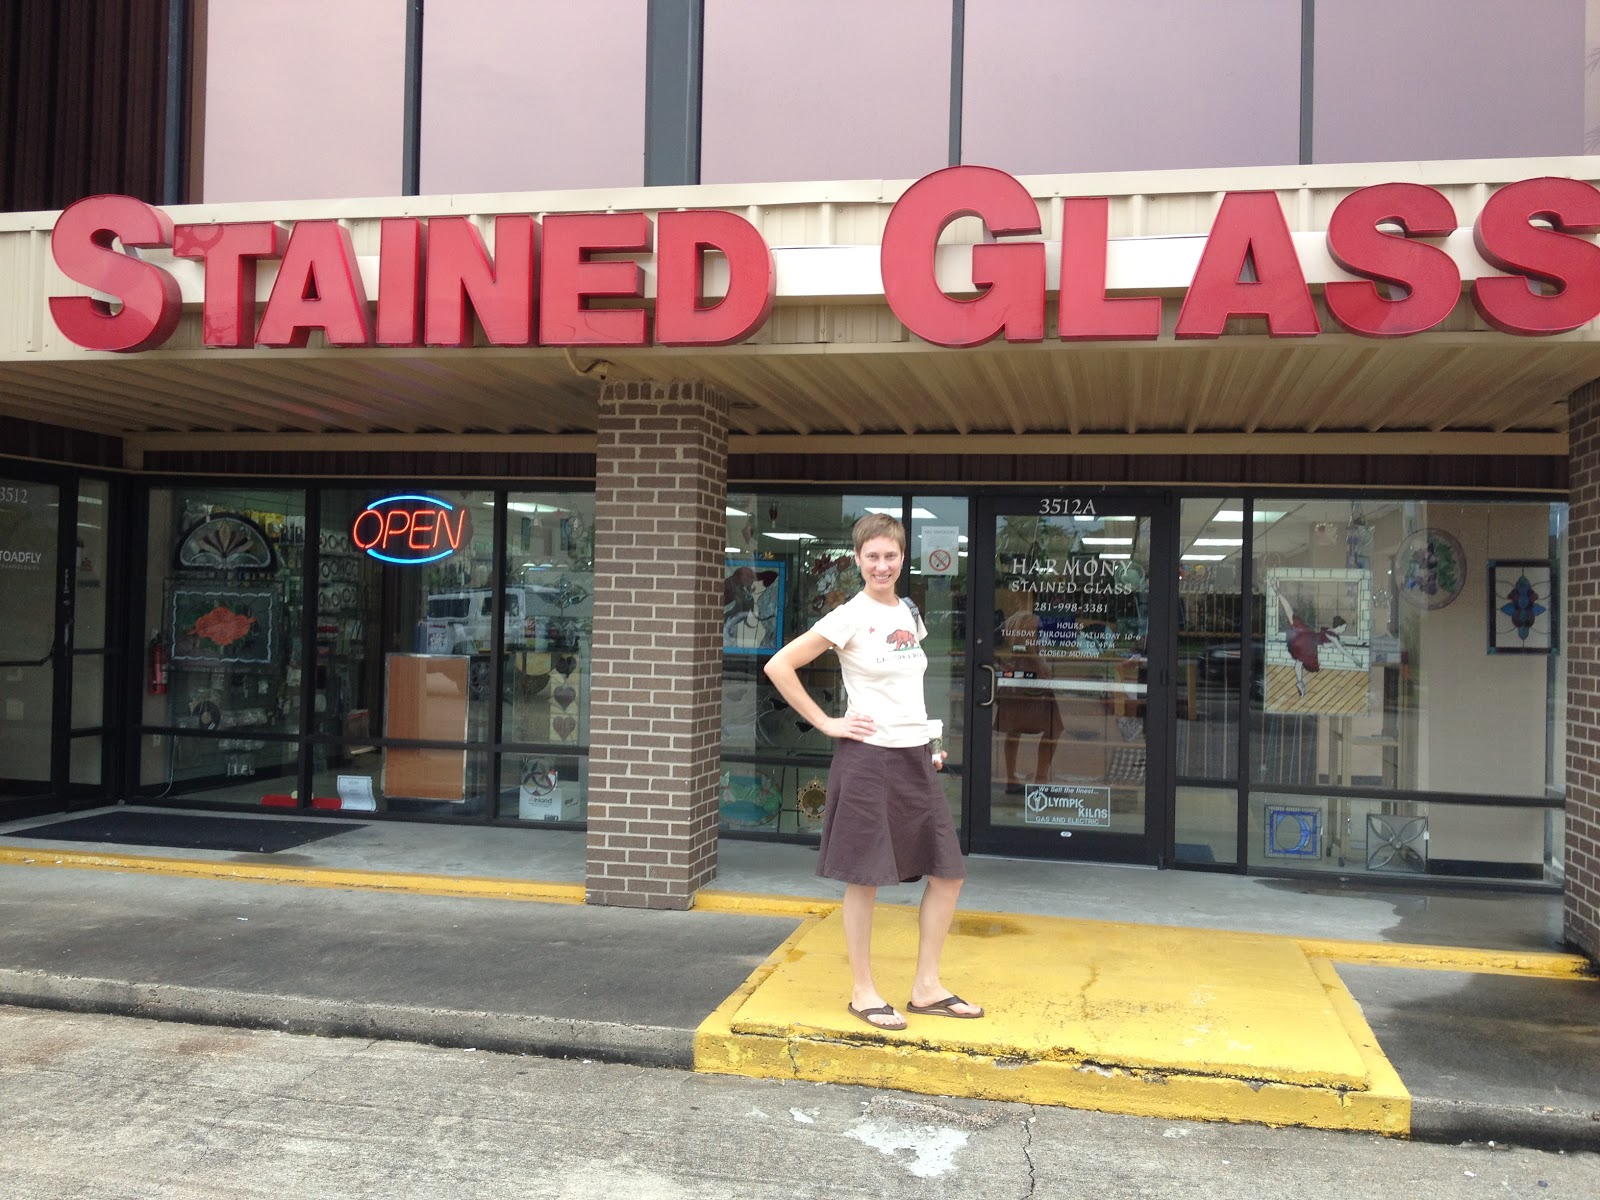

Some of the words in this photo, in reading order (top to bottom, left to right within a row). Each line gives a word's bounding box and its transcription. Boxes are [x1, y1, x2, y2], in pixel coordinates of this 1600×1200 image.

[49, 193, 777, 354] STAINED
[880, 165, 1600, 348] GLASS
[0, 486, 28, 504] 3512
[1038, 498, 1097, 516] 3512A
[352, 509, 466, 550] OPEN
[1012, 558, 1133, 576] HARMONY
[1010, 579, 1078, 594] STAINED
[1083, 581, 1133, 595] GLASS
[1033, 602, 1108, 613] 281-998-3381
[1056, 621, 1084, 631] HOURS
[1001, 628, 1036, 638] TUESDAY
[1038, 630, 1077, 640] THROUGH
[1079, 631, 1121, 641] SATURDAY
[1024, 638, 1056, 648] SUNDAY
[1059, 639, 1082, 649] NOON
[1085, 641, 1096, 649] TO
[1038, 649, 1067, 659] CLOSED
[1068, 650, 1101, 660] MONDAY
[1078, 808, 1107, 819] KILNS
[1035, 815, 1050, 823] GAS
[1051, 816, 1067, 824] AND
[1067, 817, 1100, 826] ELECTRIC
